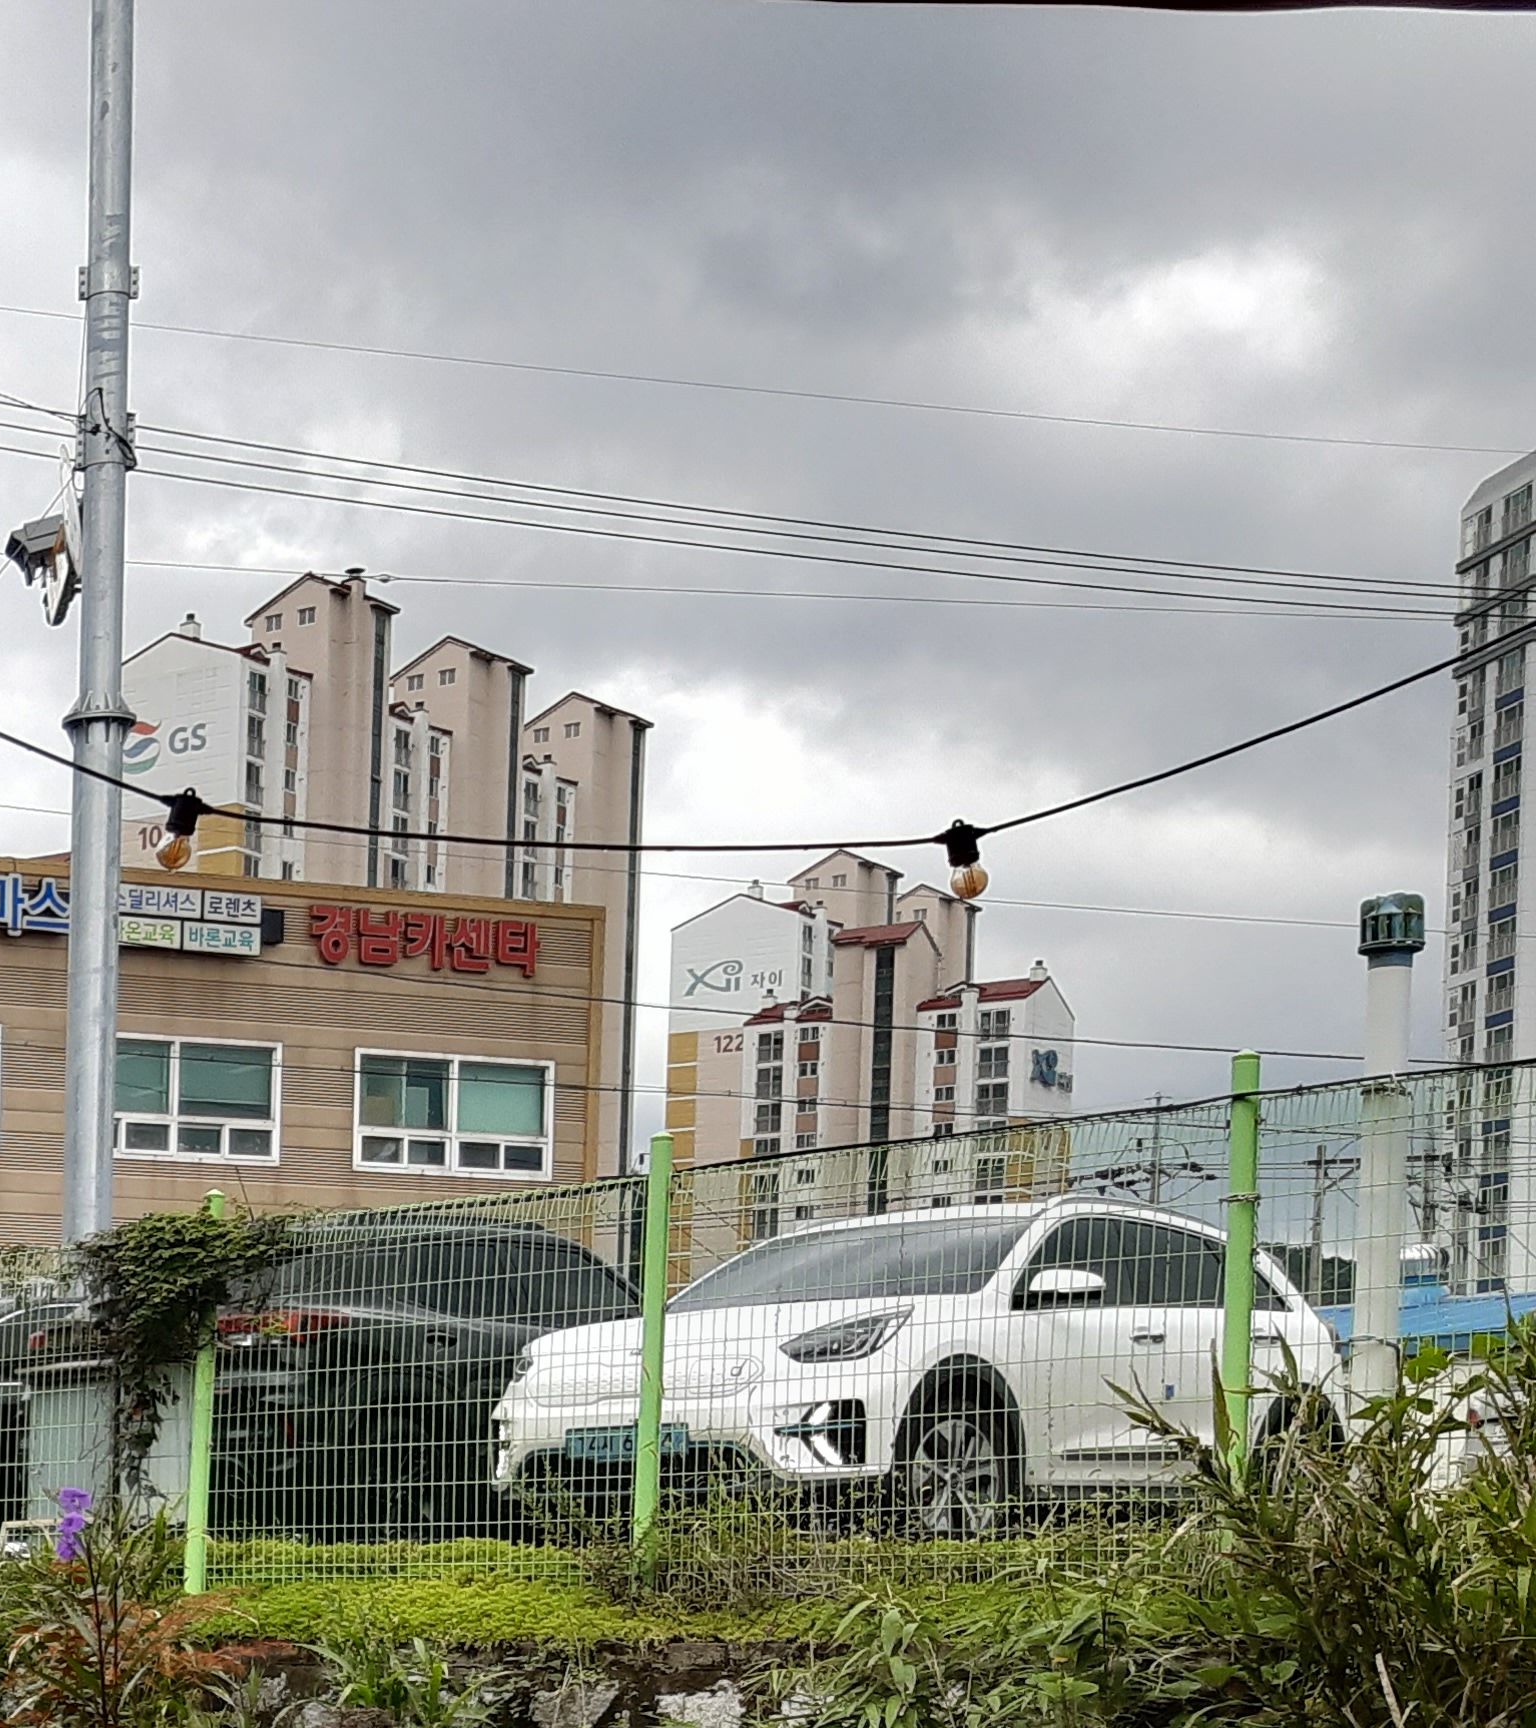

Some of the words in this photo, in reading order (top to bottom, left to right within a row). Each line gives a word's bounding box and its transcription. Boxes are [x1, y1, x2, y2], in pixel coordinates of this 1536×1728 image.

[168, 723, 207, 755] GS
[207, 895, 258, 919] 로렌츠
[188, 926, 255, 952] 바론교육
[308, 902, 542, 978] 경남카센타
[750, 969, 783, 989] 자이
[713, 1034, 744, 1054] 122
